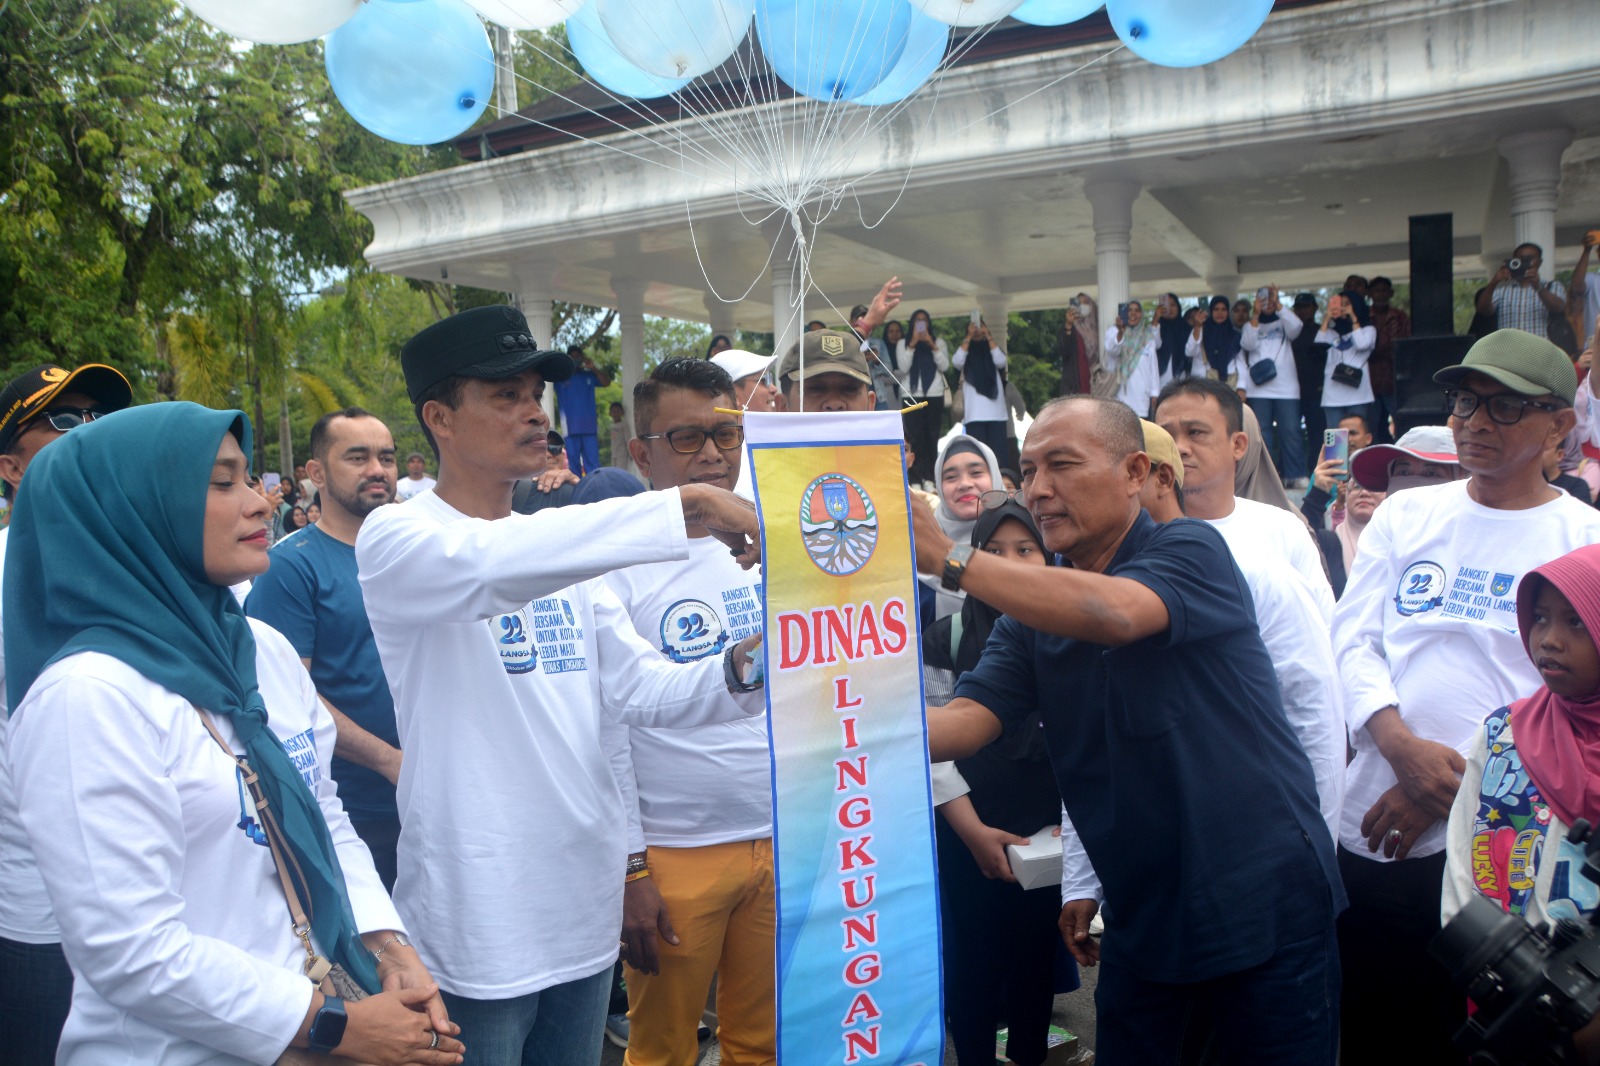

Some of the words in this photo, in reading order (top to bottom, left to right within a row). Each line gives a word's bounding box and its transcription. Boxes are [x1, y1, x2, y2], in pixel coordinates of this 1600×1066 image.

[1458, 566, 1489, 581] BANGKIT
[1406, 574, 1432, 594] 22
[1453, 578, 1485, 594] BERSAMA
[722, 586, 750, 602] BANGKIT
[1448, 589, 1472, 604] UNTUK
[1472, 594, 1492, 608] KOTA
[1493, 599, 1517, 613] LANGS
[532, 599, 559, 613] BANGKIT
[725, 599, 756, 615] BERSAMA
[1443, 601, 1465, 616] LEBIH
[1465, 606, 1486, 620] MAJU
[534, 614, 564, 628] BERSAMA
[677, 613, 709, 642] 22
[728, 613, 750, 628] UNTUK
[500, 615, 526, 644] 22
[536, 629, 558, 643] UNTUK
[560, 628, 575, 640] KOTA
[731, 627, 750, 641] LEBIH
[778, 601, 907, 669] DINAS
[539, 645, 558, 658] LEBIH
[560, 643, 575, 656] MAJU
[682, 641, 711, 652] LANGSA
[283, 733, 309, 754] NGKIT
[1473, 834, 1499, 892] LUCKY
[1510, 832, 1533, 883] LIFE
[835, 678, 881, 1061] LINGKUNGAN
